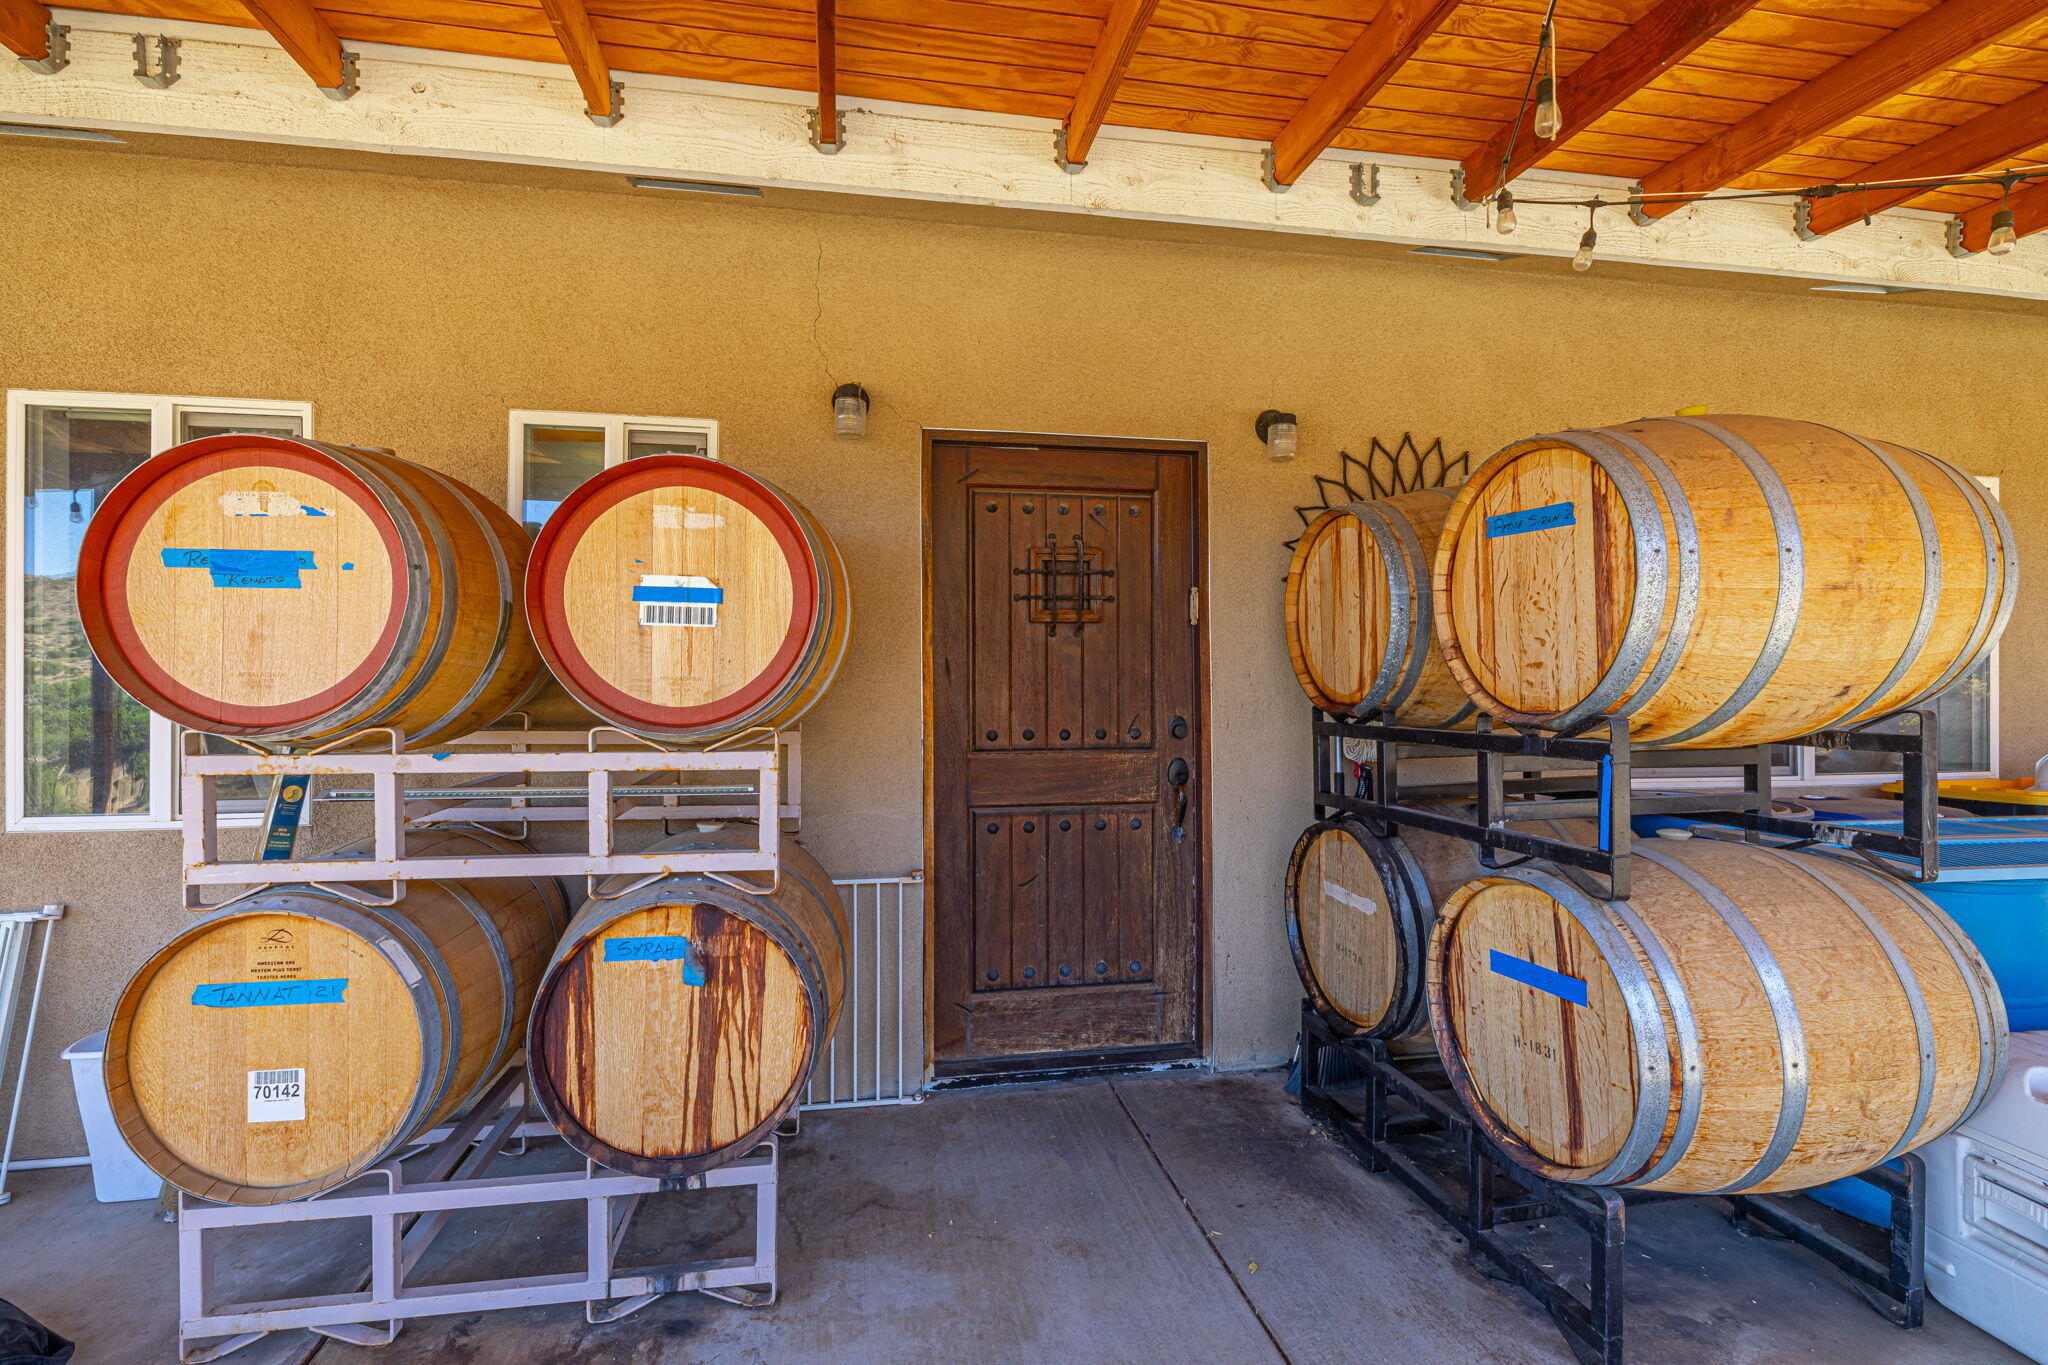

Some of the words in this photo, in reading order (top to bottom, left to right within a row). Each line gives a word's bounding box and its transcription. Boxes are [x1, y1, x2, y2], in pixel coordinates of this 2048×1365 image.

[616, 940, 676, 957] SYRAH
[212, 984, 302, 1006] TANNAT
[314, 985, 336, 998] 21
[1513, 1034, 1557, 1063] H-1831
[253, 1083, 300, 1100] 70142
